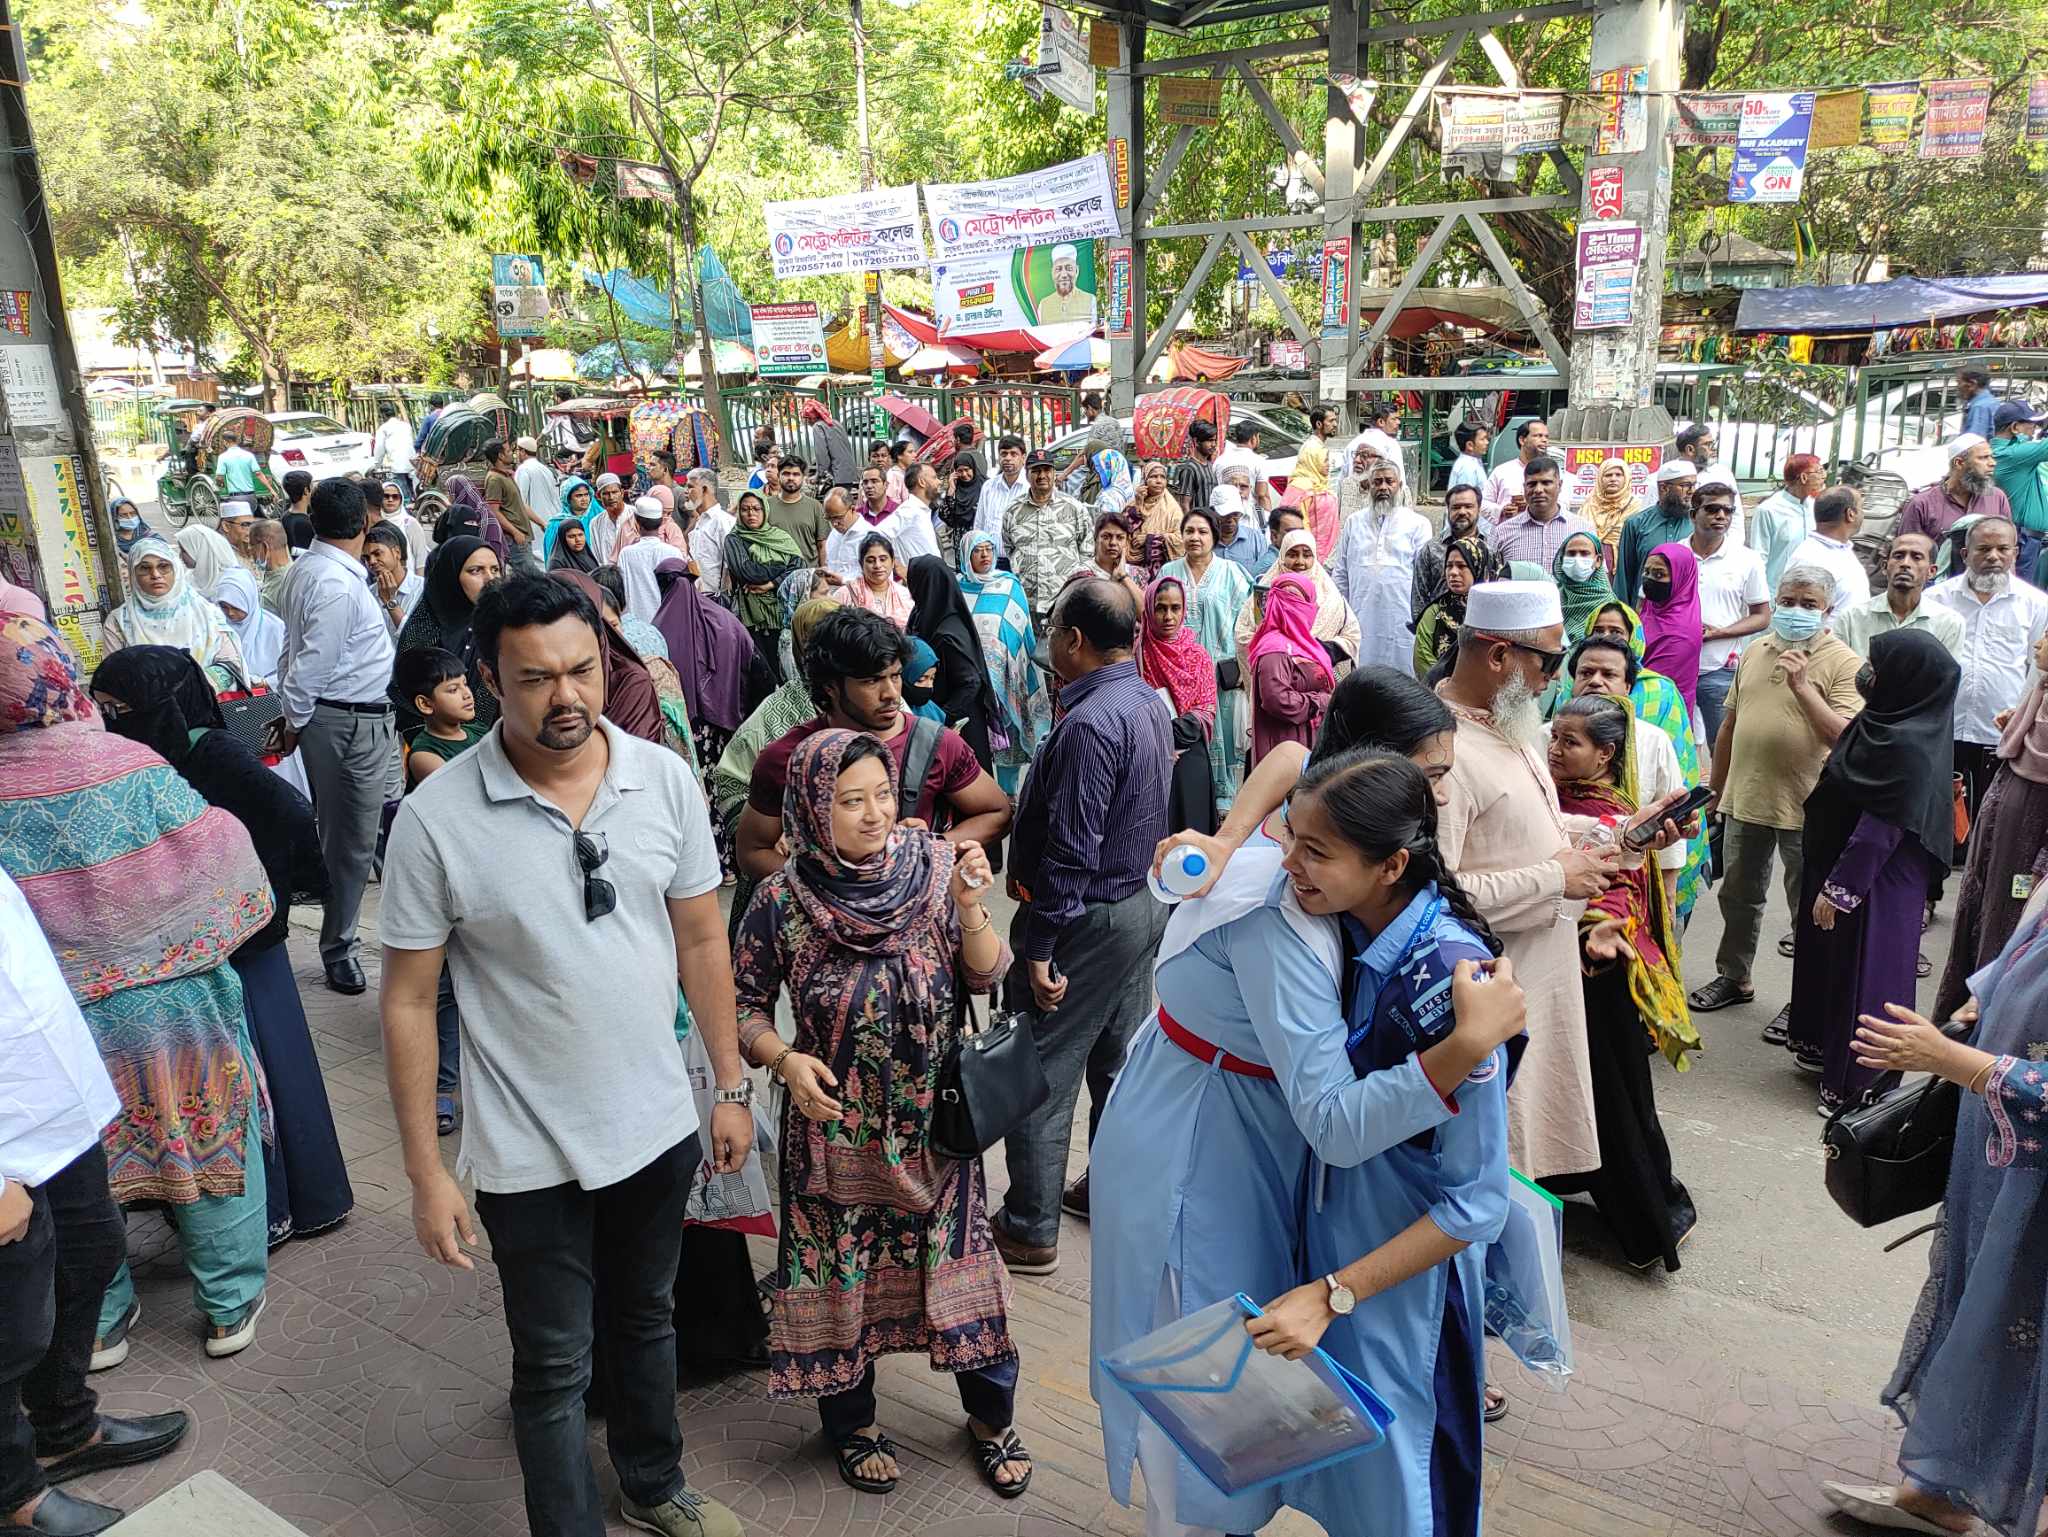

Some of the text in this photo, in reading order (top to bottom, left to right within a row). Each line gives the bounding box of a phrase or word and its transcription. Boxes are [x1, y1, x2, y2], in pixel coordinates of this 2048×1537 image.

[964, 196, 1103, 236] মেট্রোপলিটন কলেজ
[797, 224, 915, 251] মেট্রোপলিটন কলেজ
[778, 261, 843, 274] 01720557140
[852, 254, 920, 267] 01720557130
[1575, 449, 1604, 464] HSC
[1624, 447, 1652, 463] HSC
[73, 458, 85, 481] 500
[78, 484, 89, 507] 500
[1418, 990, 1452, 1017] BMSC
